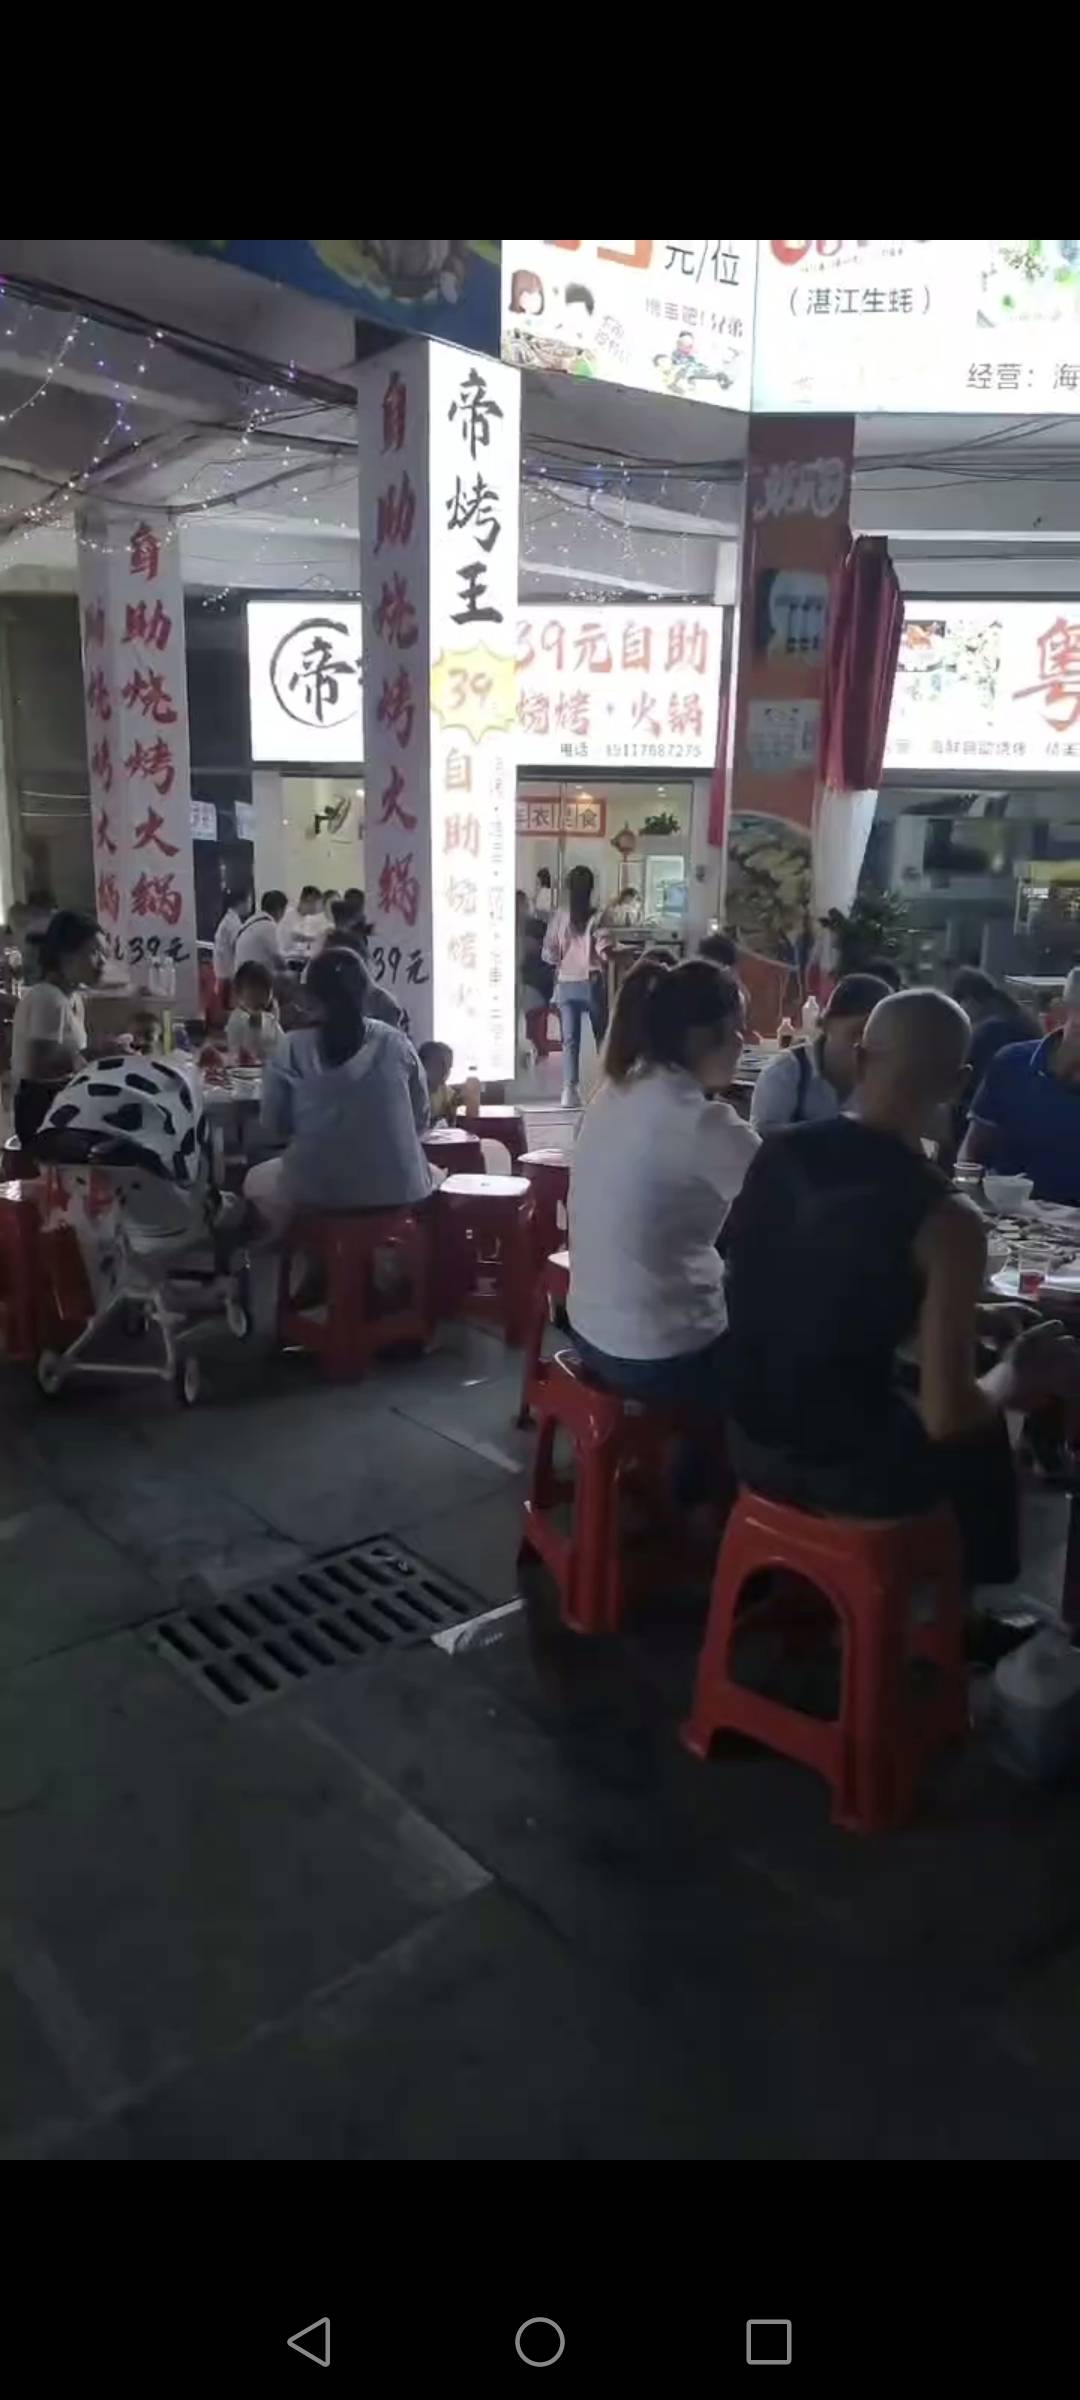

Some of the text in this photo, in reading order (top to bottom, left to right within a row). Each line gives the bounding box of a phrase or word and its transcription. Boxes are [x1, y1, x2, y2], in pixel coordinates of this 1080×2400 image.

[445, 367, 505, 626] 帝烤王
[373, 369, 421, 928] 自助烧烤火锅
[515, 618, 710, 677] 39元自助
[287, 636, 362, 723] 帝
[446, 667, 495, 711] 39
[119, 521, 184, 927] 自助烧烤火锅
[559, 741, 589, 759] 电话
[128, 934, 190, 965] 39元
[371, 945, 430, 986] 39元
